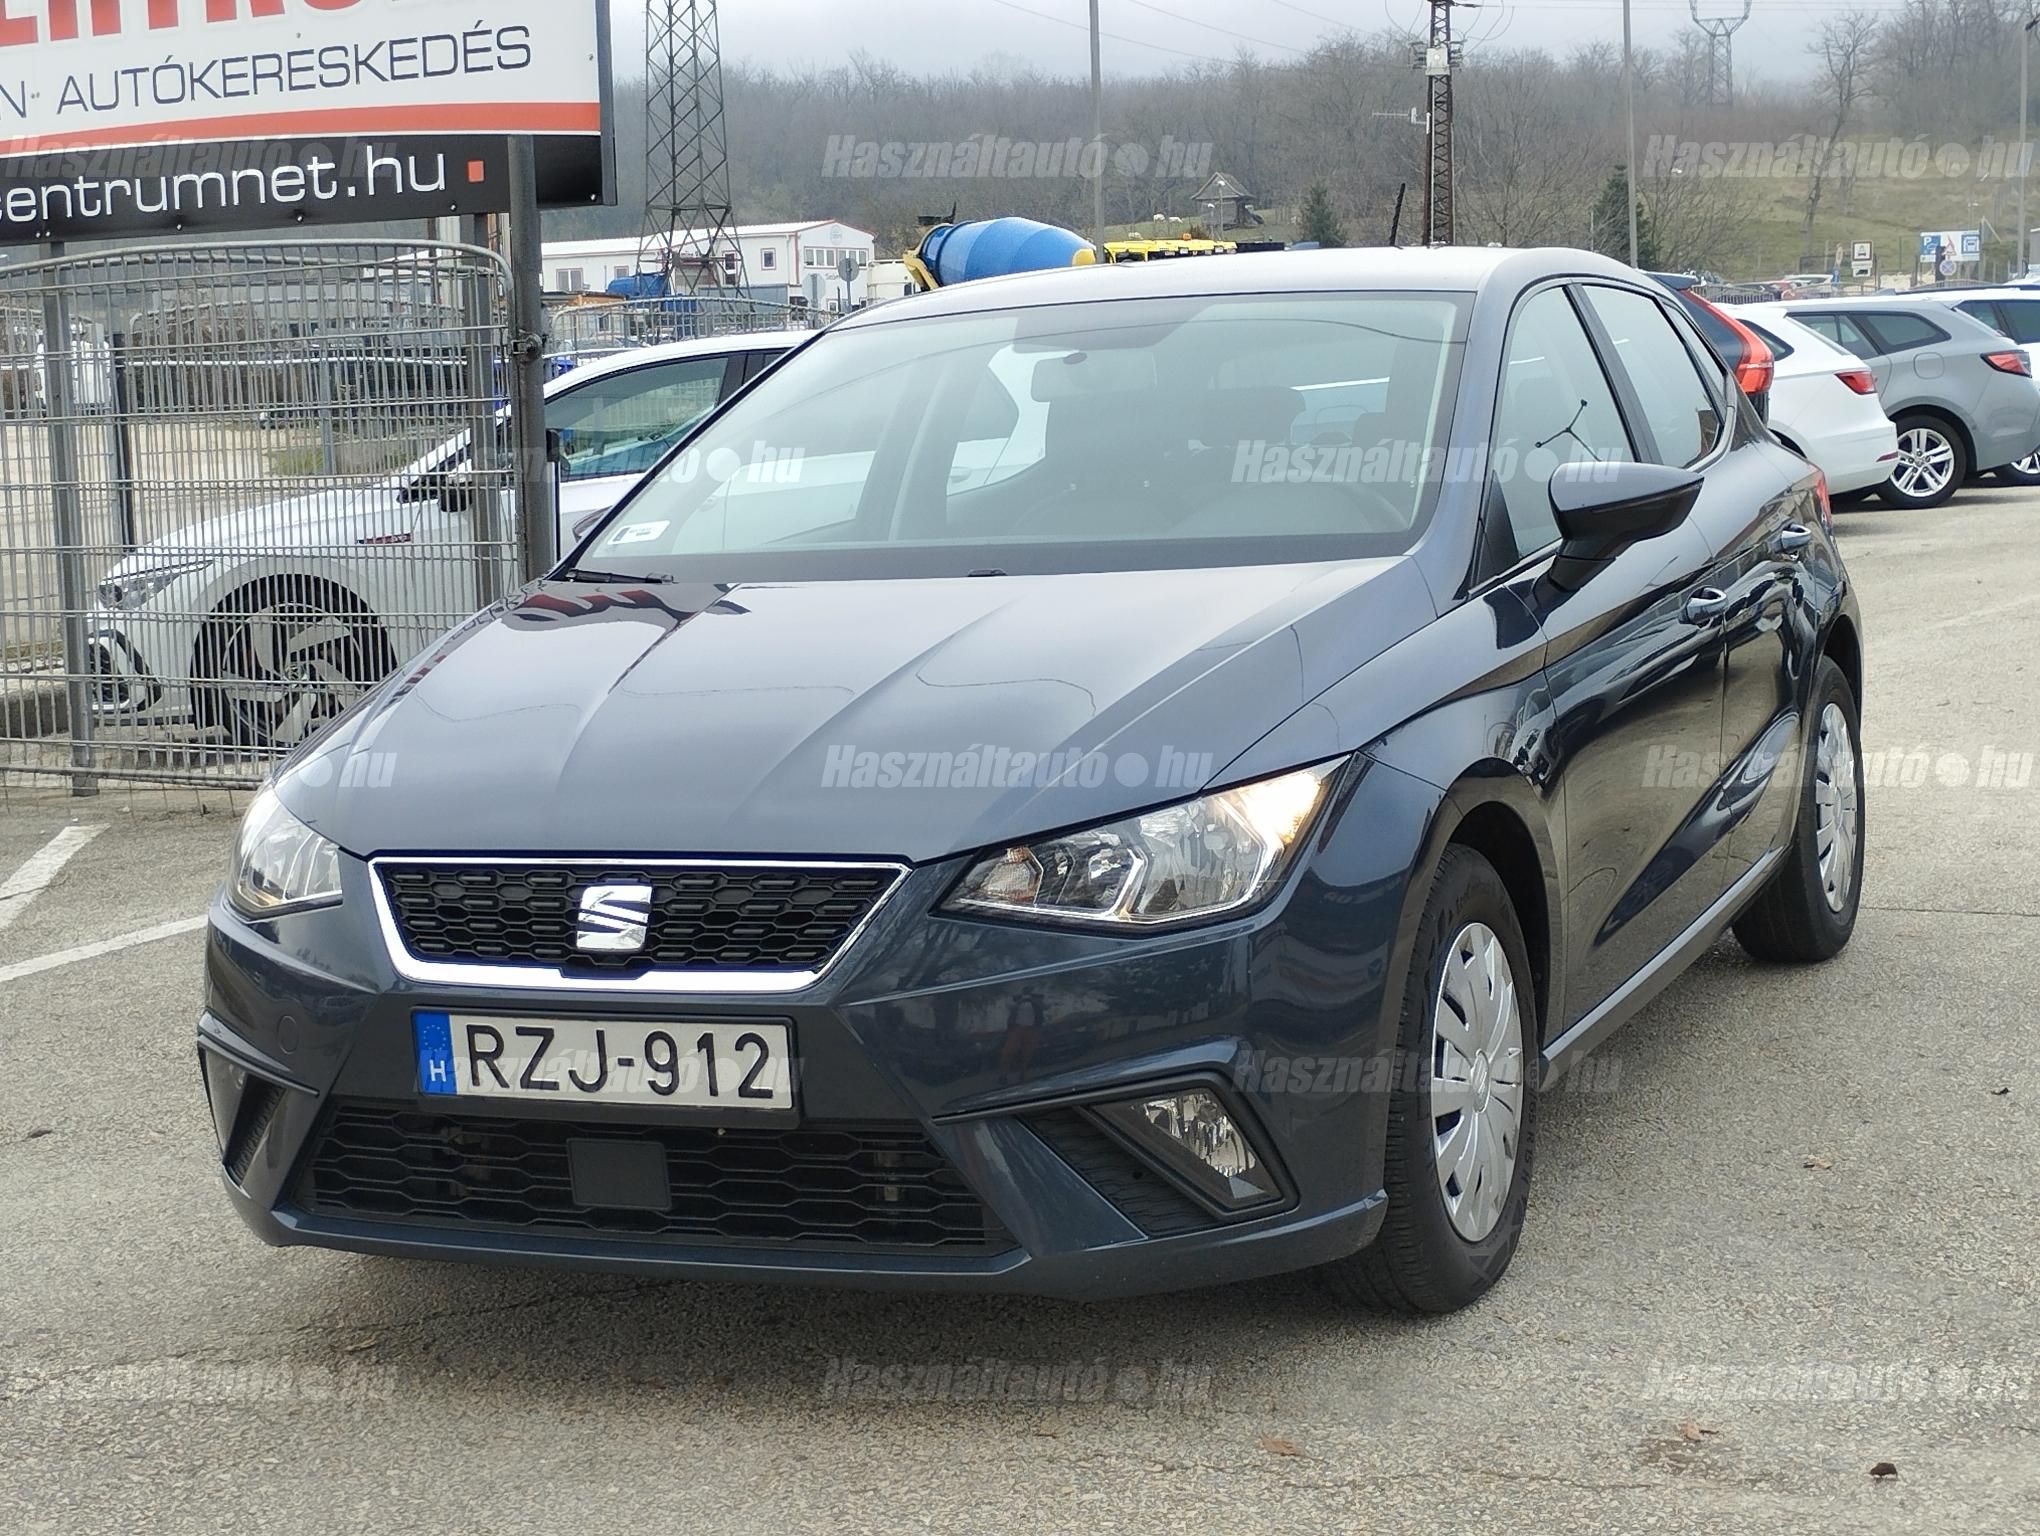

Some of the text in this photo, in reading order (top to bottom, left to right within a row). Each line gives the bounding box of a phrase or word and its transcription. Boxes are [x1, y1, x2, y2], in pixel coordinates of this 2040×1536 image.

[57, 20, 531, 115] AUTÓKERESKEDÉS
[429, 1060, 447, 1083] H
[465, 1024, 774, 1099] RZJ-912
